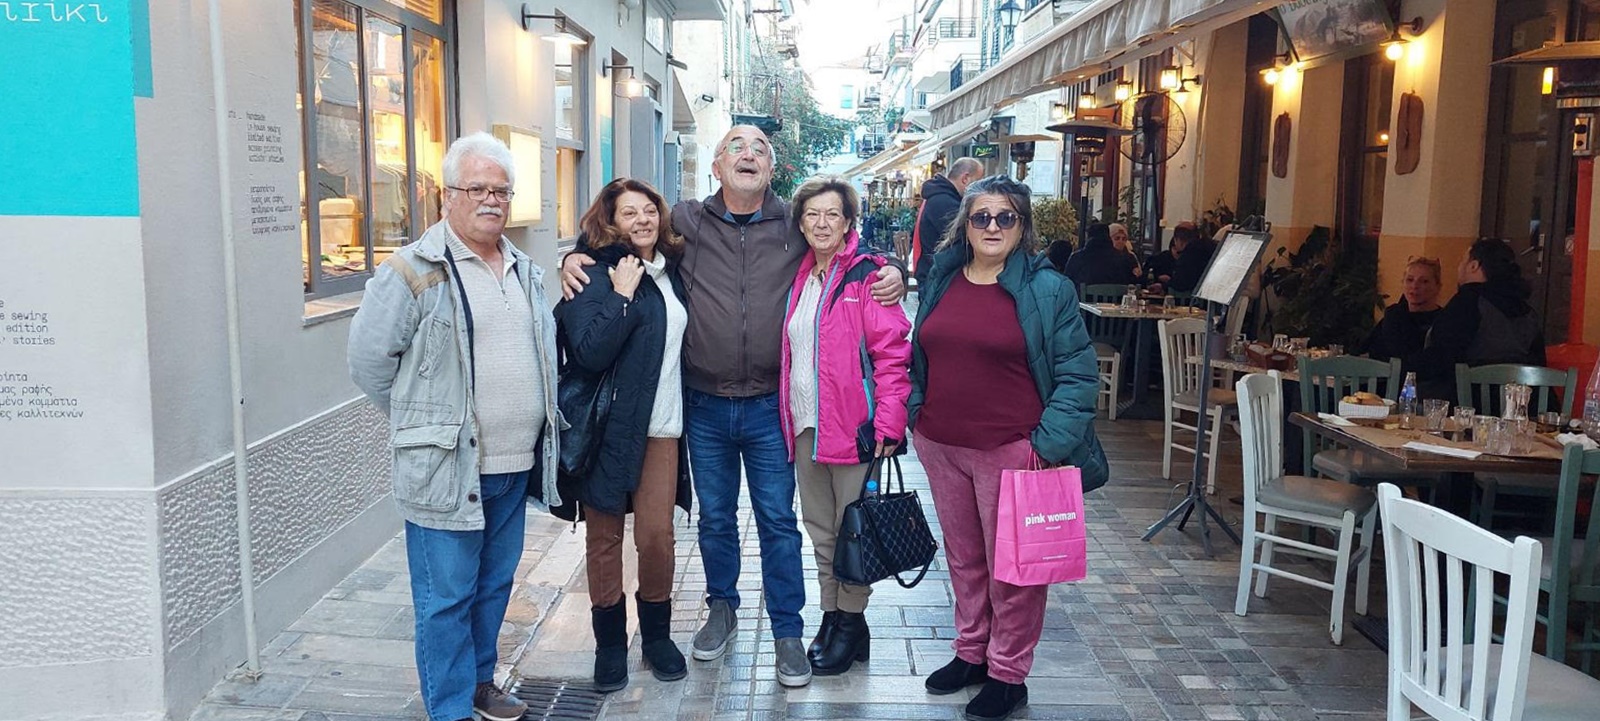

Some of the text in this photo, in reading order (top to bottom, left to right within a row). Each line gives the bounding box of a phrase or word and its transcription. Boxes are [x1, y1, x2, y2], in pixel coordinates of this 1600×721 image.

[11, 309, 48, 323] sewing
[6, 322, 49, 333] edition
[12, 335, 56, 345] stories
[1025, 513, 1046, 527] pink
[1047, 511, 1077, 522] woman
